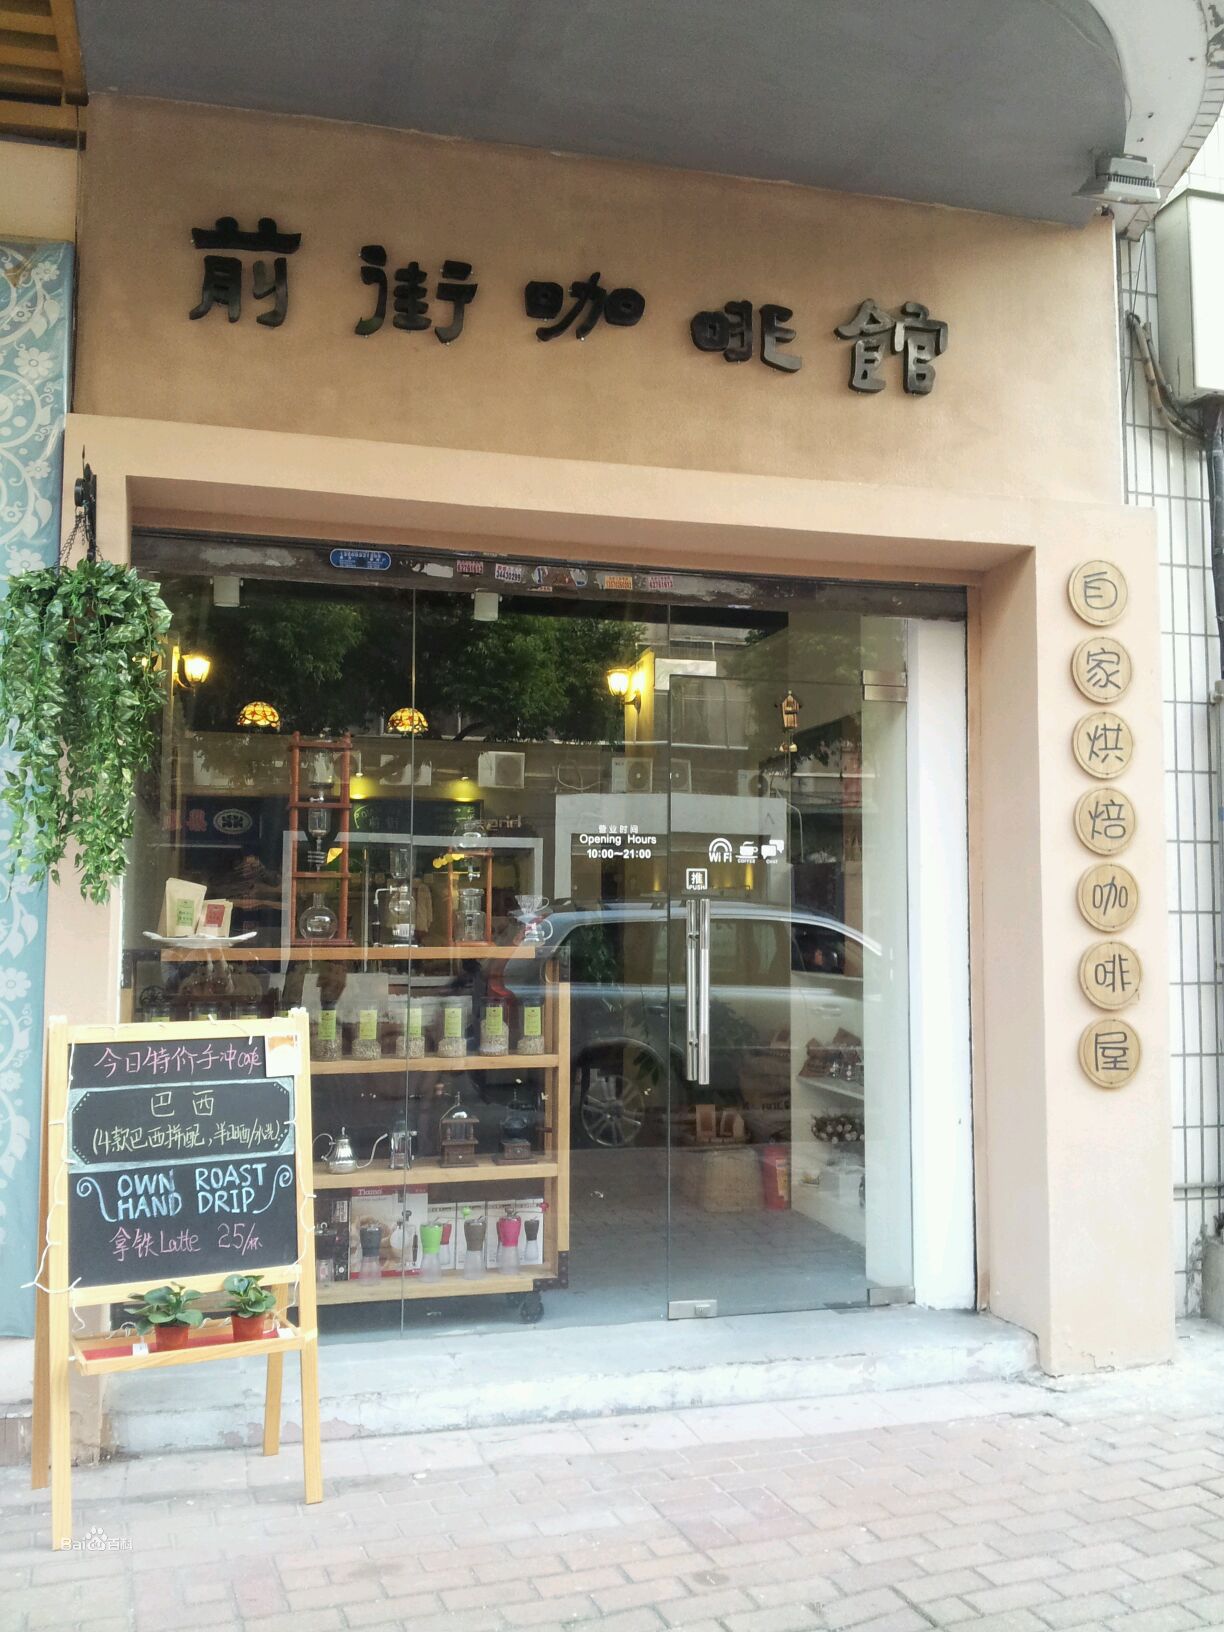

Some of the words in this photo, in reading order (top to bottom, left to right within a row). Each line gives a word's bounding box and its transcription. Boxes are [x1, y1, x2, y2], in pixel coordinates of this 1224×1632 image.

[598, 825, 639, 834] 营业时间
[580, 834, 622, 846] Opening
[627, 834, 657, 844] Hours
[691, 872, 704, 885] 推
[117, 1168, 176, 1197] OWN
[195, 1163, 267, 1191] ROAST
[117, 1192, 182, 1221] HAND
[198, 1187, 256, 1214] DRIP
